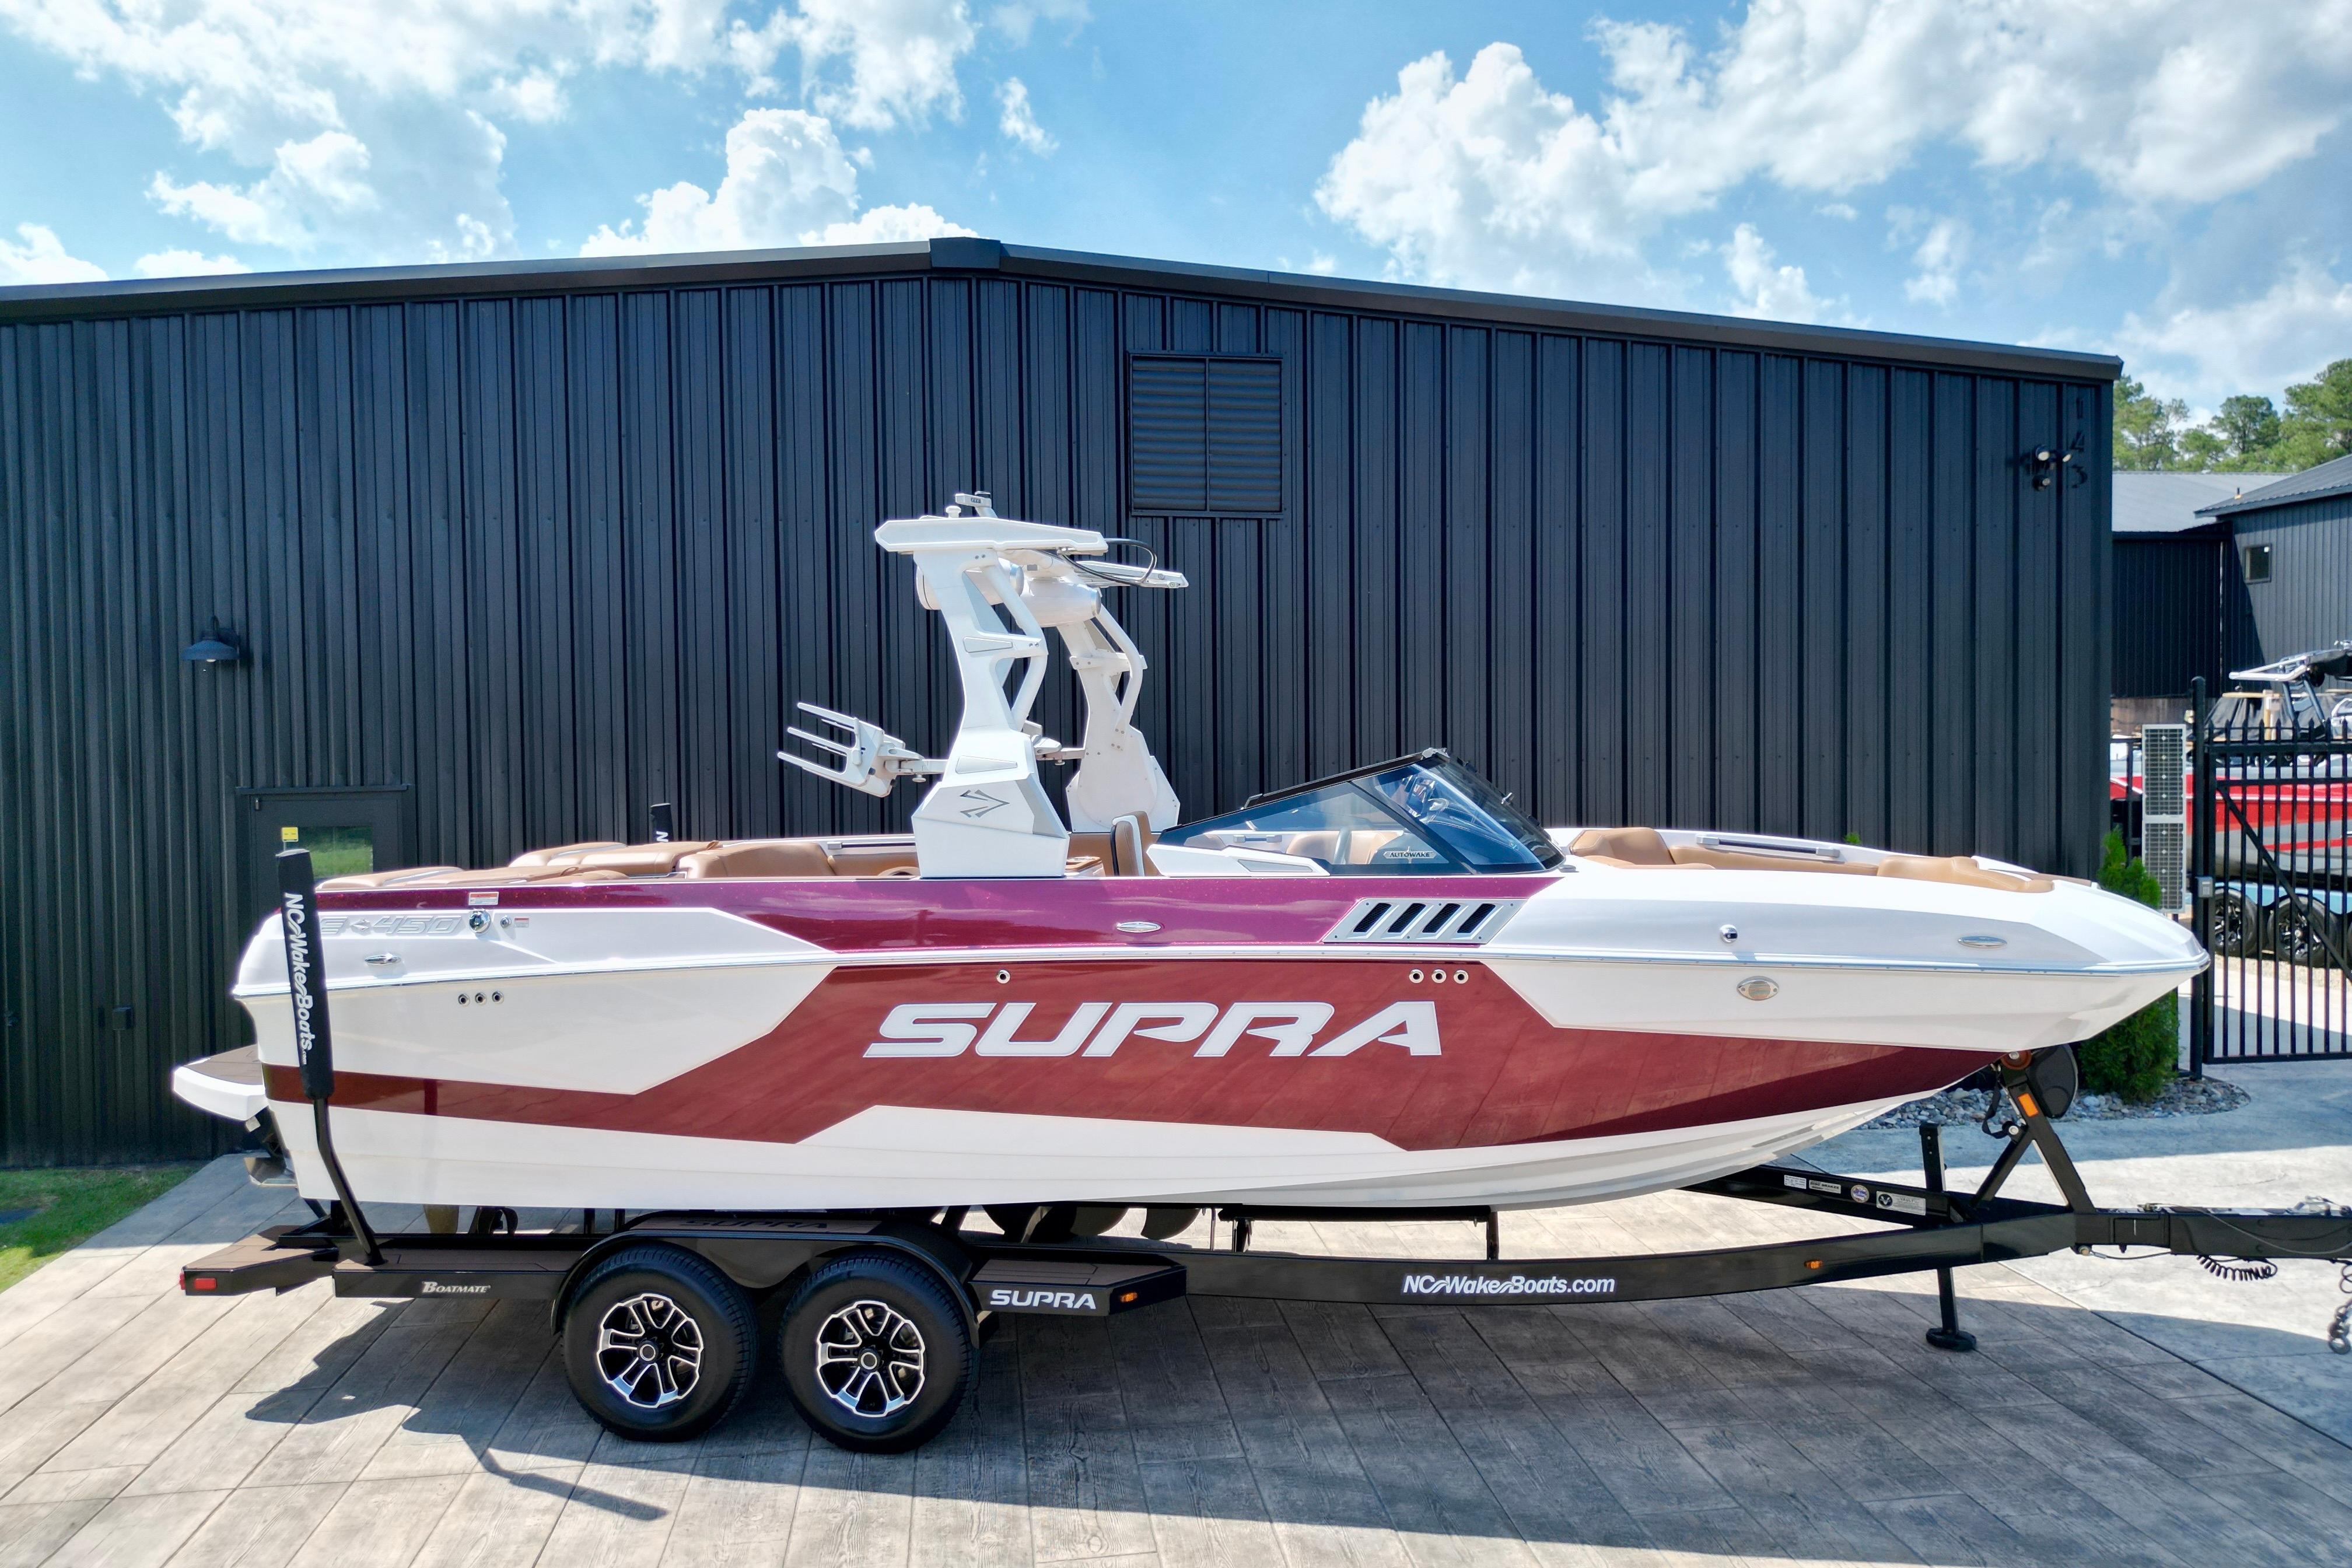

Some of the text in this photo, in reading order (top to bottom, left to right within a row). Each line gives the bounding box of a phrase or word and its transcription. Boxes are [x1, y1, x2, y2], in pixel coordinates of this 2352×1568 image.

[372, 916, 463, 934] 450
[862, 1001, 1443, 1057] SUPRA
[680, 1220, 827, 1228] SUPRA
[991, 1290, 1096, 1310] SUPRA
